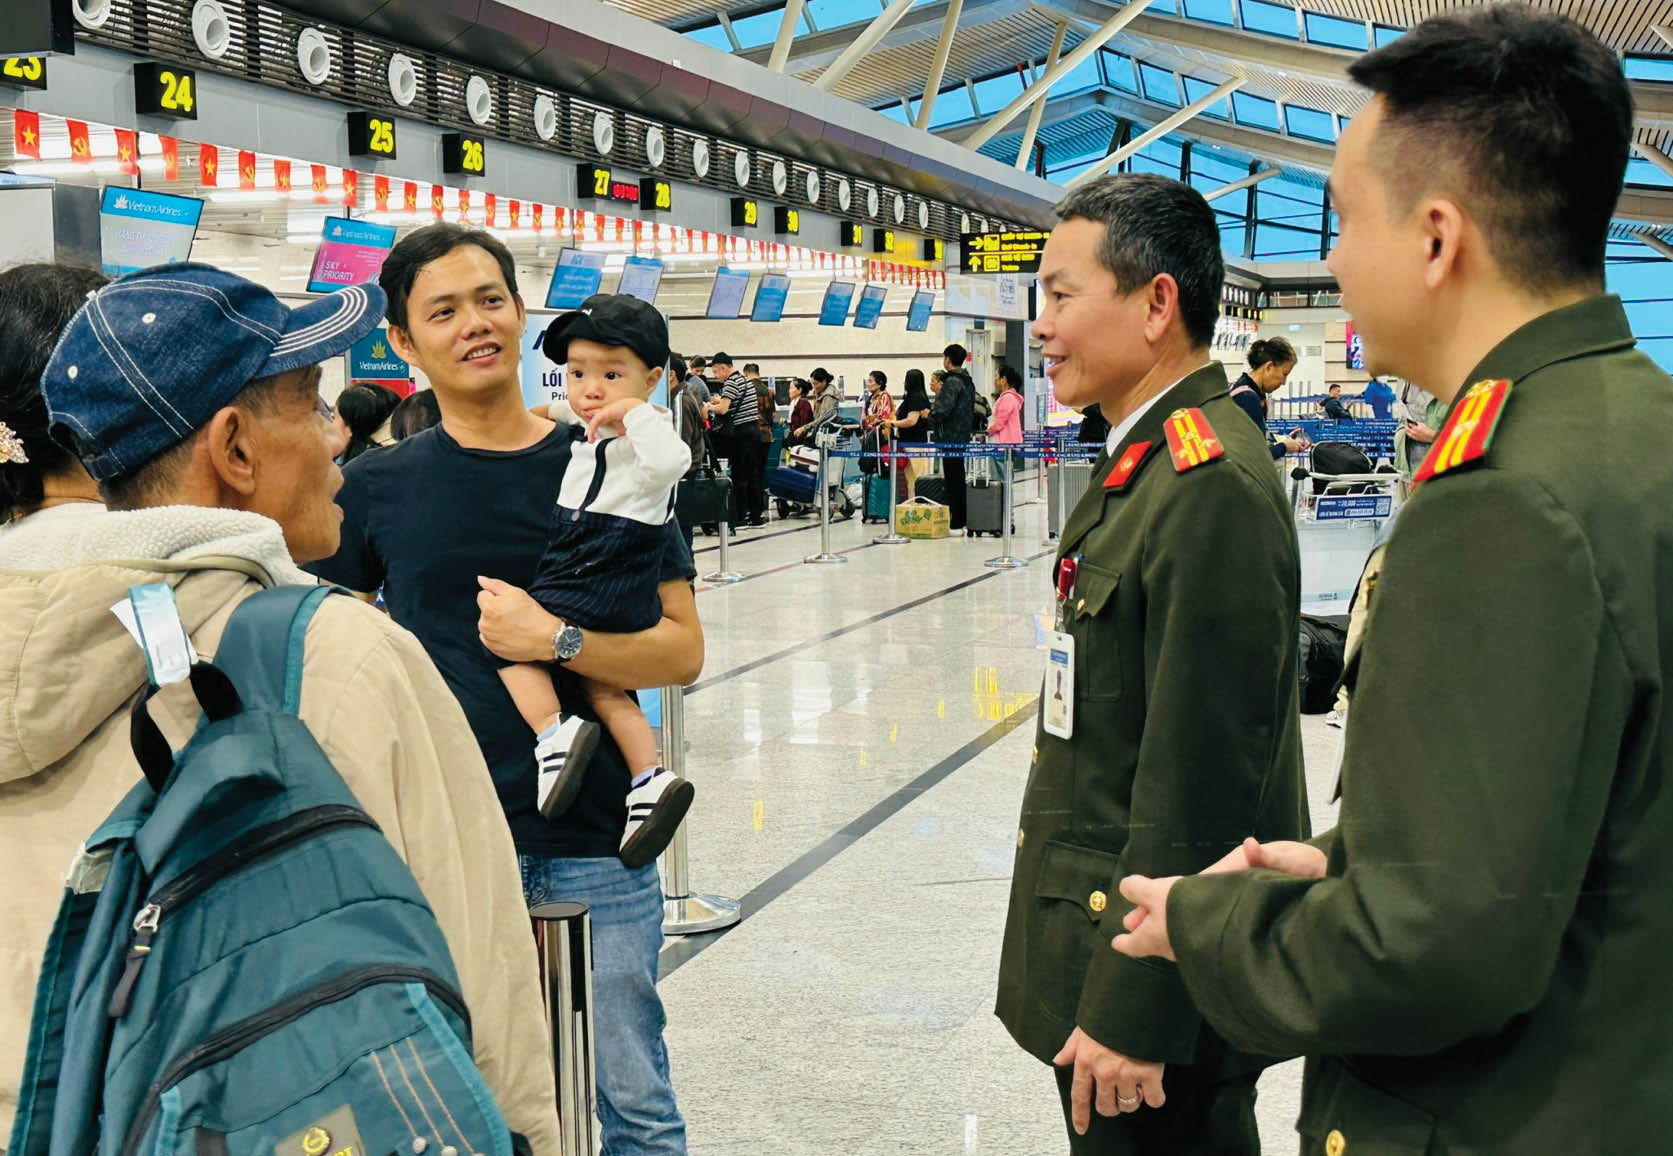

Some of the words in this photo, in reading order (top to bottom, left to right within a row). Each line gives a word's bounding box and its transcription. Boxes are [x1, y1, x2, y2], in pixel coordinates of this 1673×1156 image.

[160, 71, 193, 112] 24
[369, 119, 394, 153] 25
[462, 140, 483, 171] 26
[594, 169, 610, 195] 27
[128, 200, 159, 214] Vietnam
[542, 367, 562, 387] LỐI
